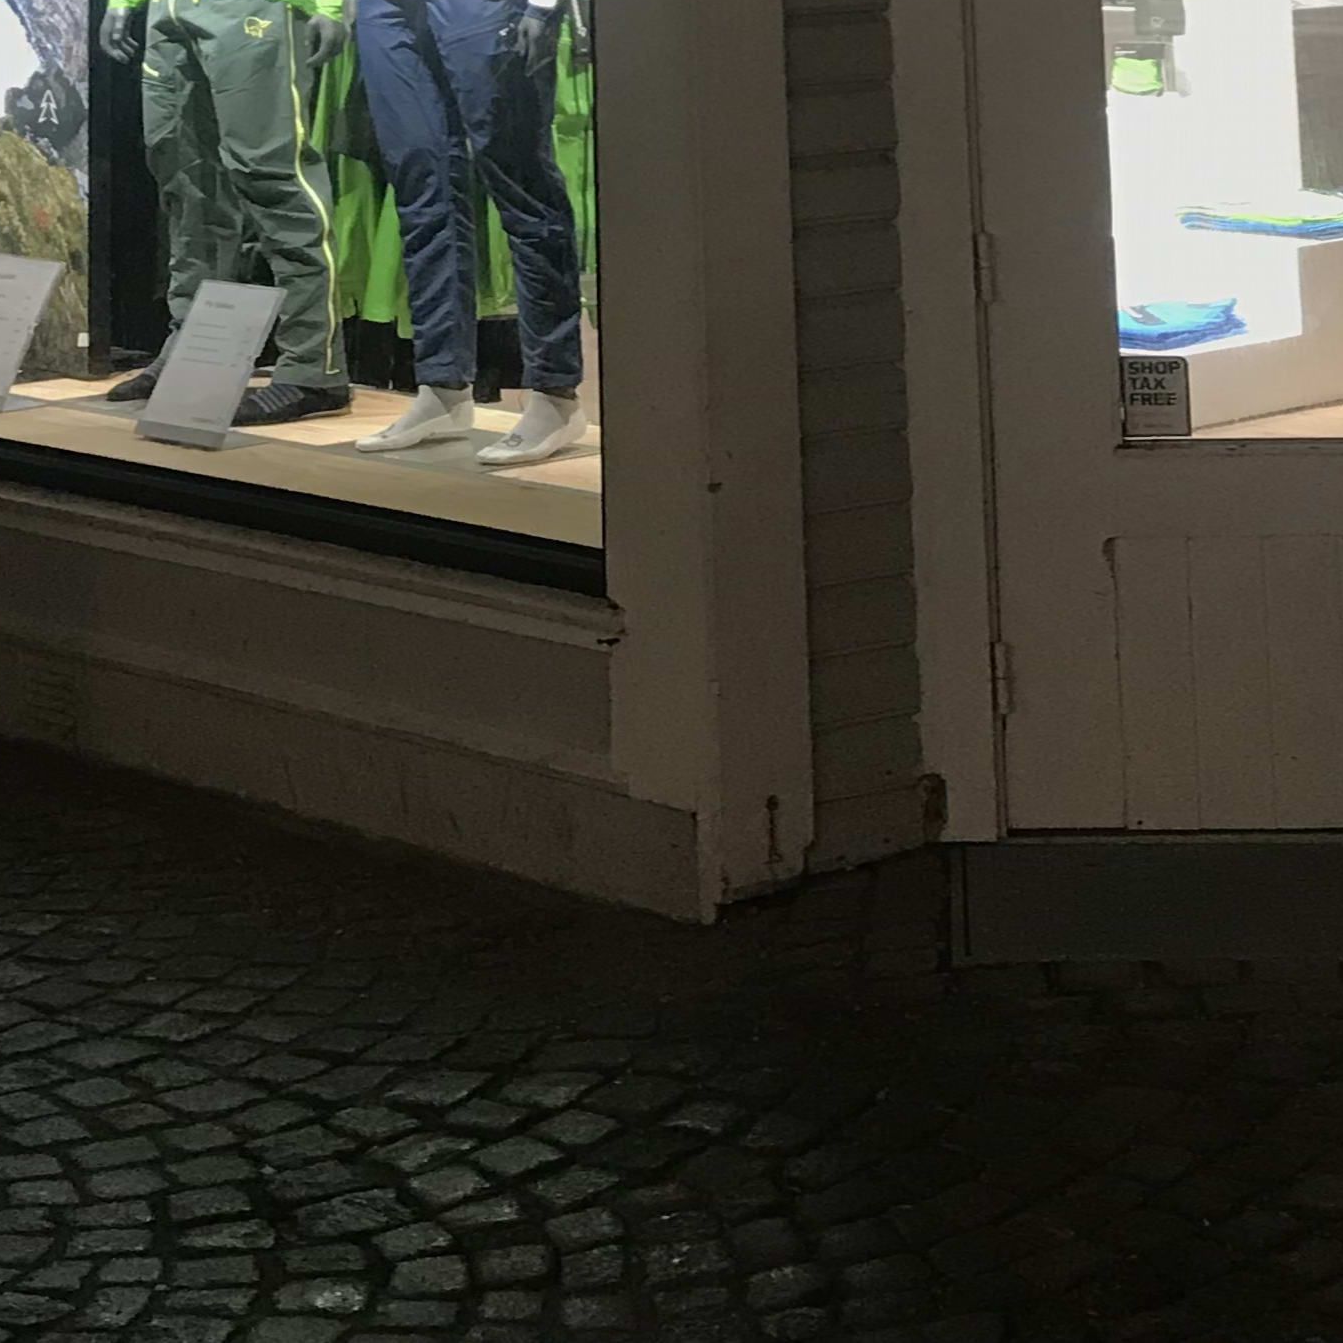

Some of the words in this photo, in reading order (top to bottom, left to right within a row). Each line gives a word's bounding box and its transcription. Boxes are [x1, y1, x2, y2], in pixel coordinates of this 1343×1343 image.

[1129, 361, 1180, 375] SHOP
[1129, 376, 1167, 390] TAX
[1130, 392, 1177, 406] FREE
